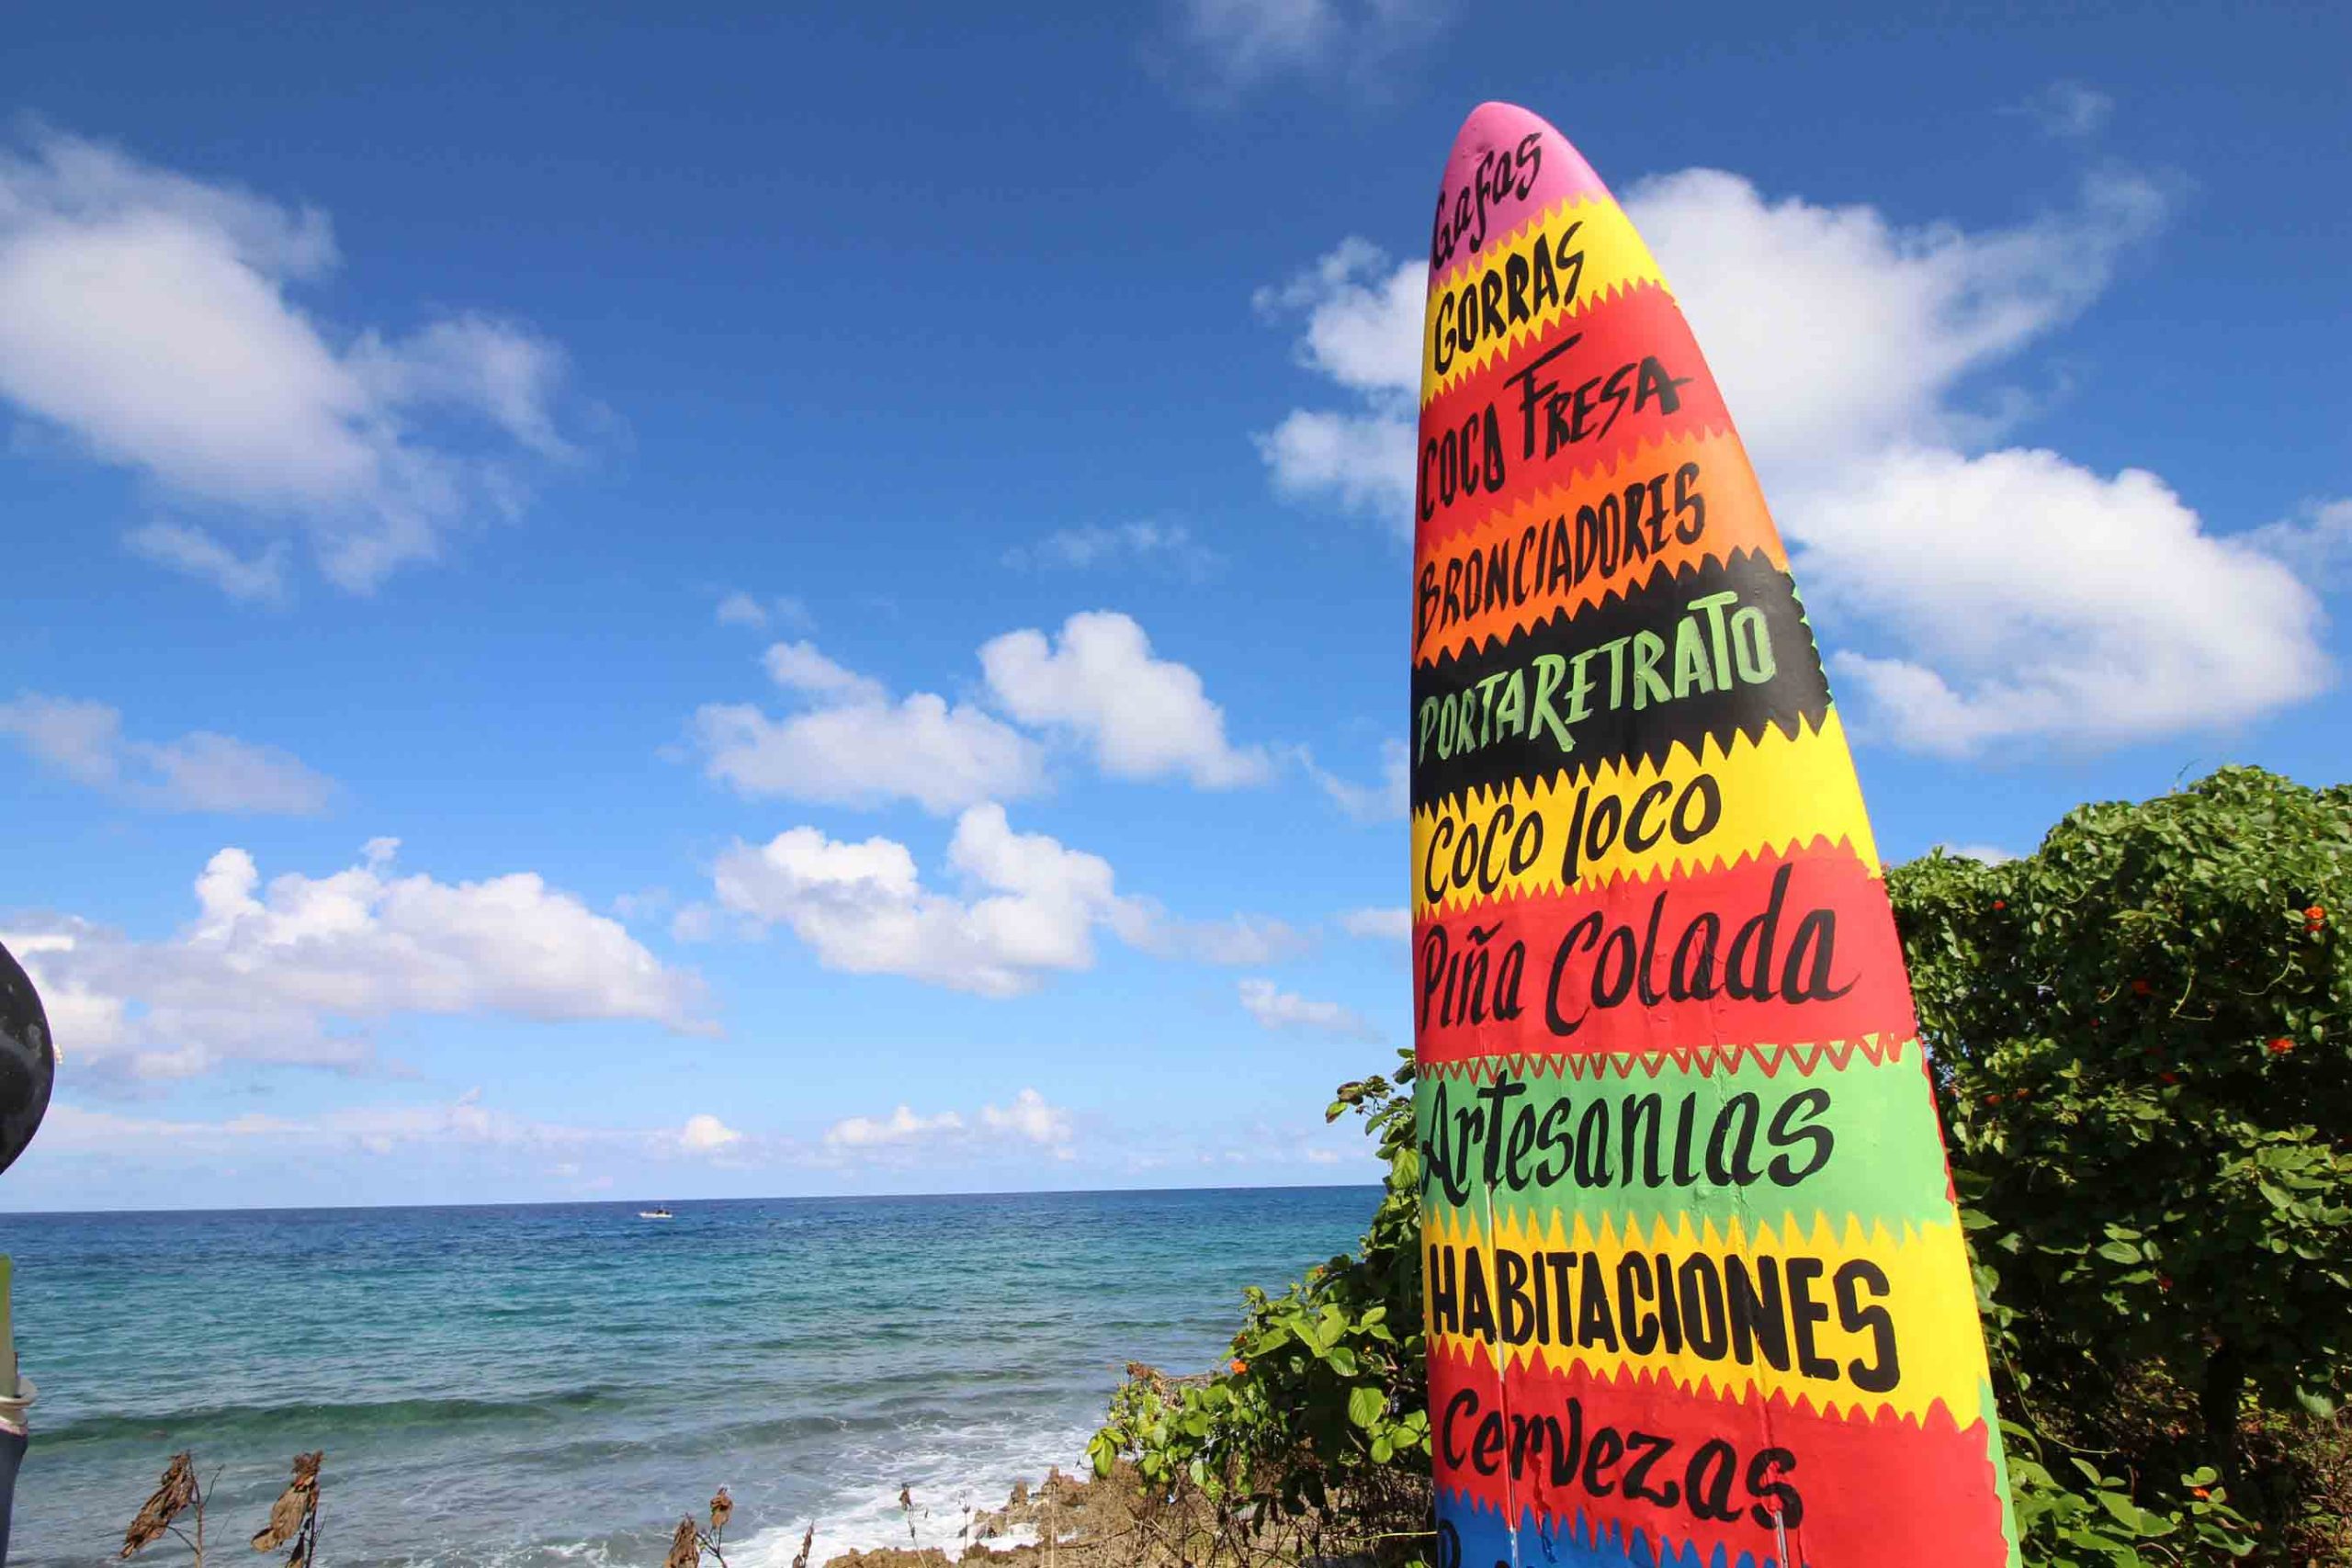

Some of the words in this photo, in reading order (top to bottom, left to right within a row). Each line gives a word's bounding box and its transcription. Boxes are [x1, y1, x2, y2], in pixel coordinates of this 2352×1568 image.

[1432, 132, 1543, 270] Gafas
[1434, 221, 1585, 375] GORRAS
[1503, 333, 1693, 460] FRESA
[1417, 461, 1706, 654] BRONCIADORES
[1419, 591, 1777, 768] PORTARETRATO
[1420, 920, 1526, 1033] Piña
[1545, 863, 1862, 1037] Colada
[1421, 1070, 1836, 1207] Artesanias
[1430, 1243, 1901, 1393] HABITACIONES
[1442, 1388, 1804, 1530] Cervezas
